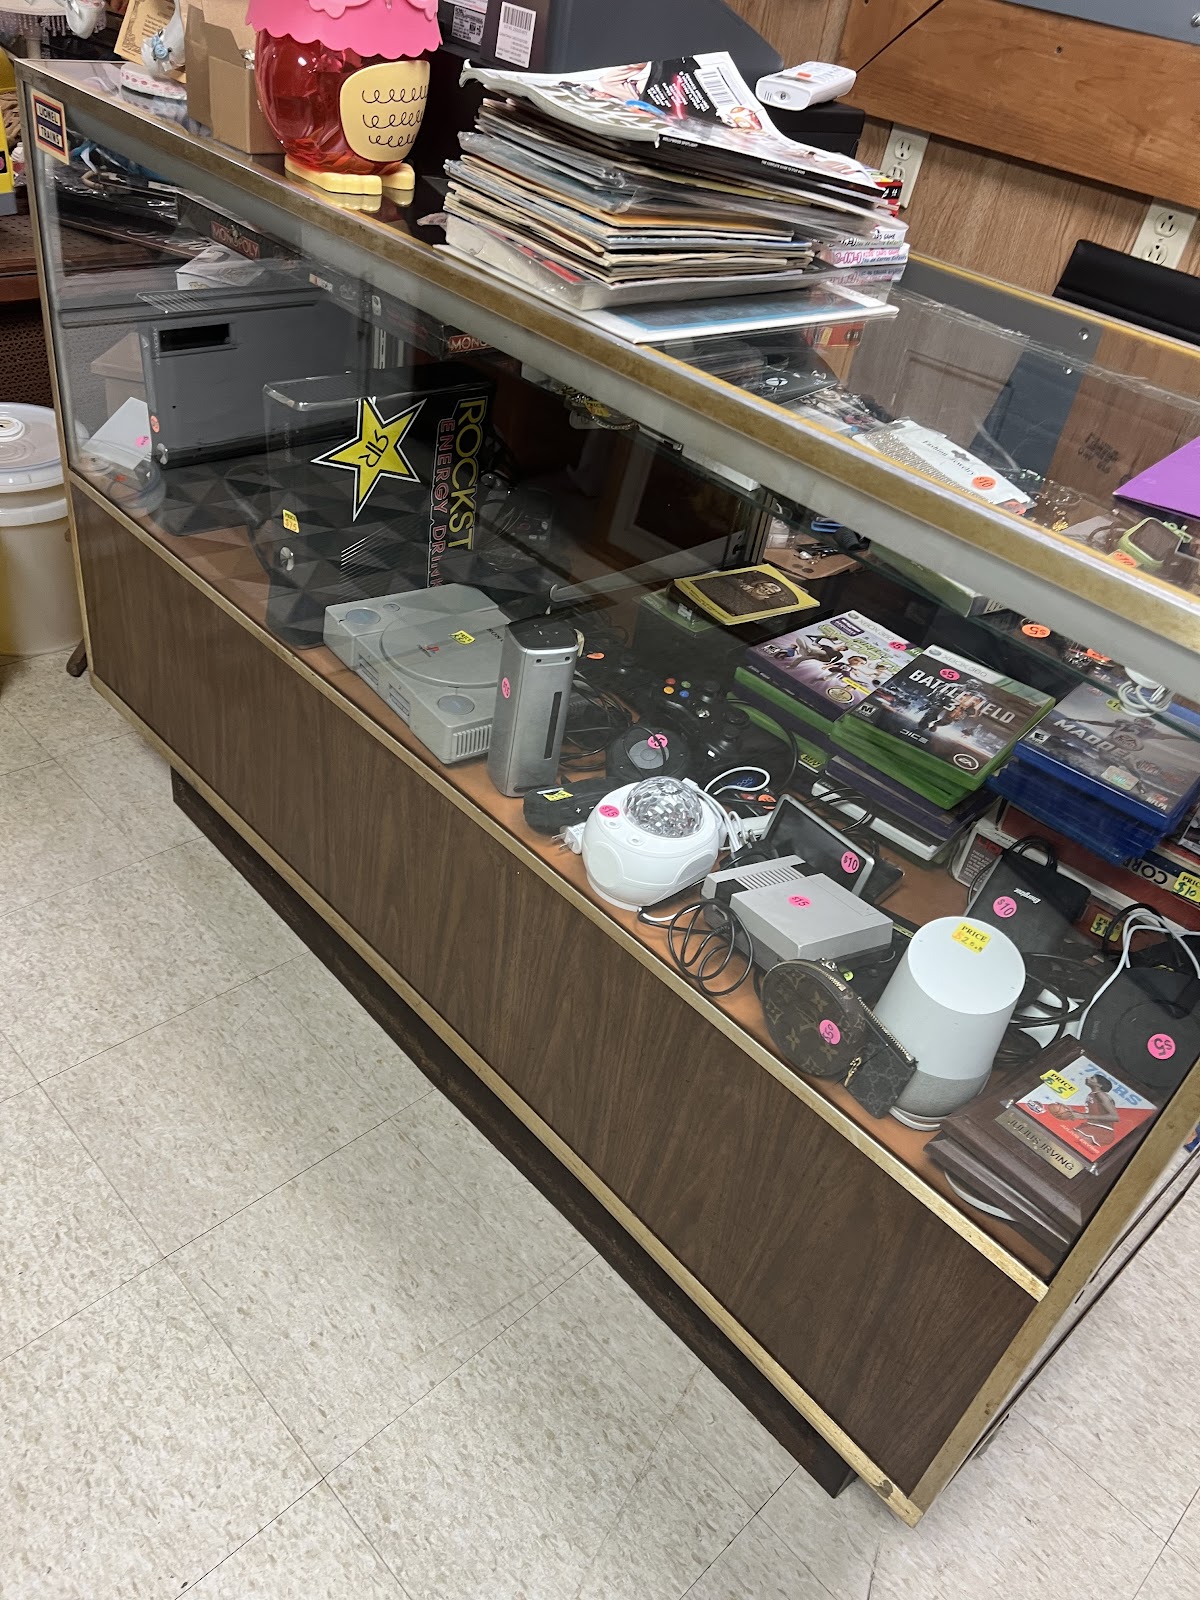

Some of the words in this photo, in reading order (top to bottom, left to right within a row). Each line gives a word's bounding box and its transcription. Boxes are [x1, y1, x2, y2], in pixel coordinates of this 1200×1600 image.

[38, 105, 59, 124] LIONEL
[41, 126, 60, 145] TRAINS
[212, 222, 259, 258] MONOPOLY
[433, 419, 456, 514] ENERGY
[922, 440, 948, 457] Fashion
[951, 458, 976, 476] Jewelry
[431, 523, 448, 588] DRINK
[941, 652, 969, 670] XBOX
[966, 664, 988, 679] 360
[942, 670, 956, 680] $5
[908, 669, 1016, 725] BATTLEFIELD
[943, 699, 960, 712] 3
[861, 704, 876, 715] M
[1054, 718, 1137, 763] MADDEN
[602, 805, 618, 817] $15
[843, 855, 858, 871] $10
[1013, 888, 1042, 905] Energizer
[1173, 881, 1198, 898] $10
[791, 896, 810, 907] $15
[997, 898, 1015, 916] $10
[961, 925, 987, 943] PRICE
[1153, 1037, 1173, 1057] $5
[1050, 1073, 1075, 1092] PRICE
[1007, 1117, 1041, 1145] JULIUS
[1040, 1143, 1075, 1172] IRVING
